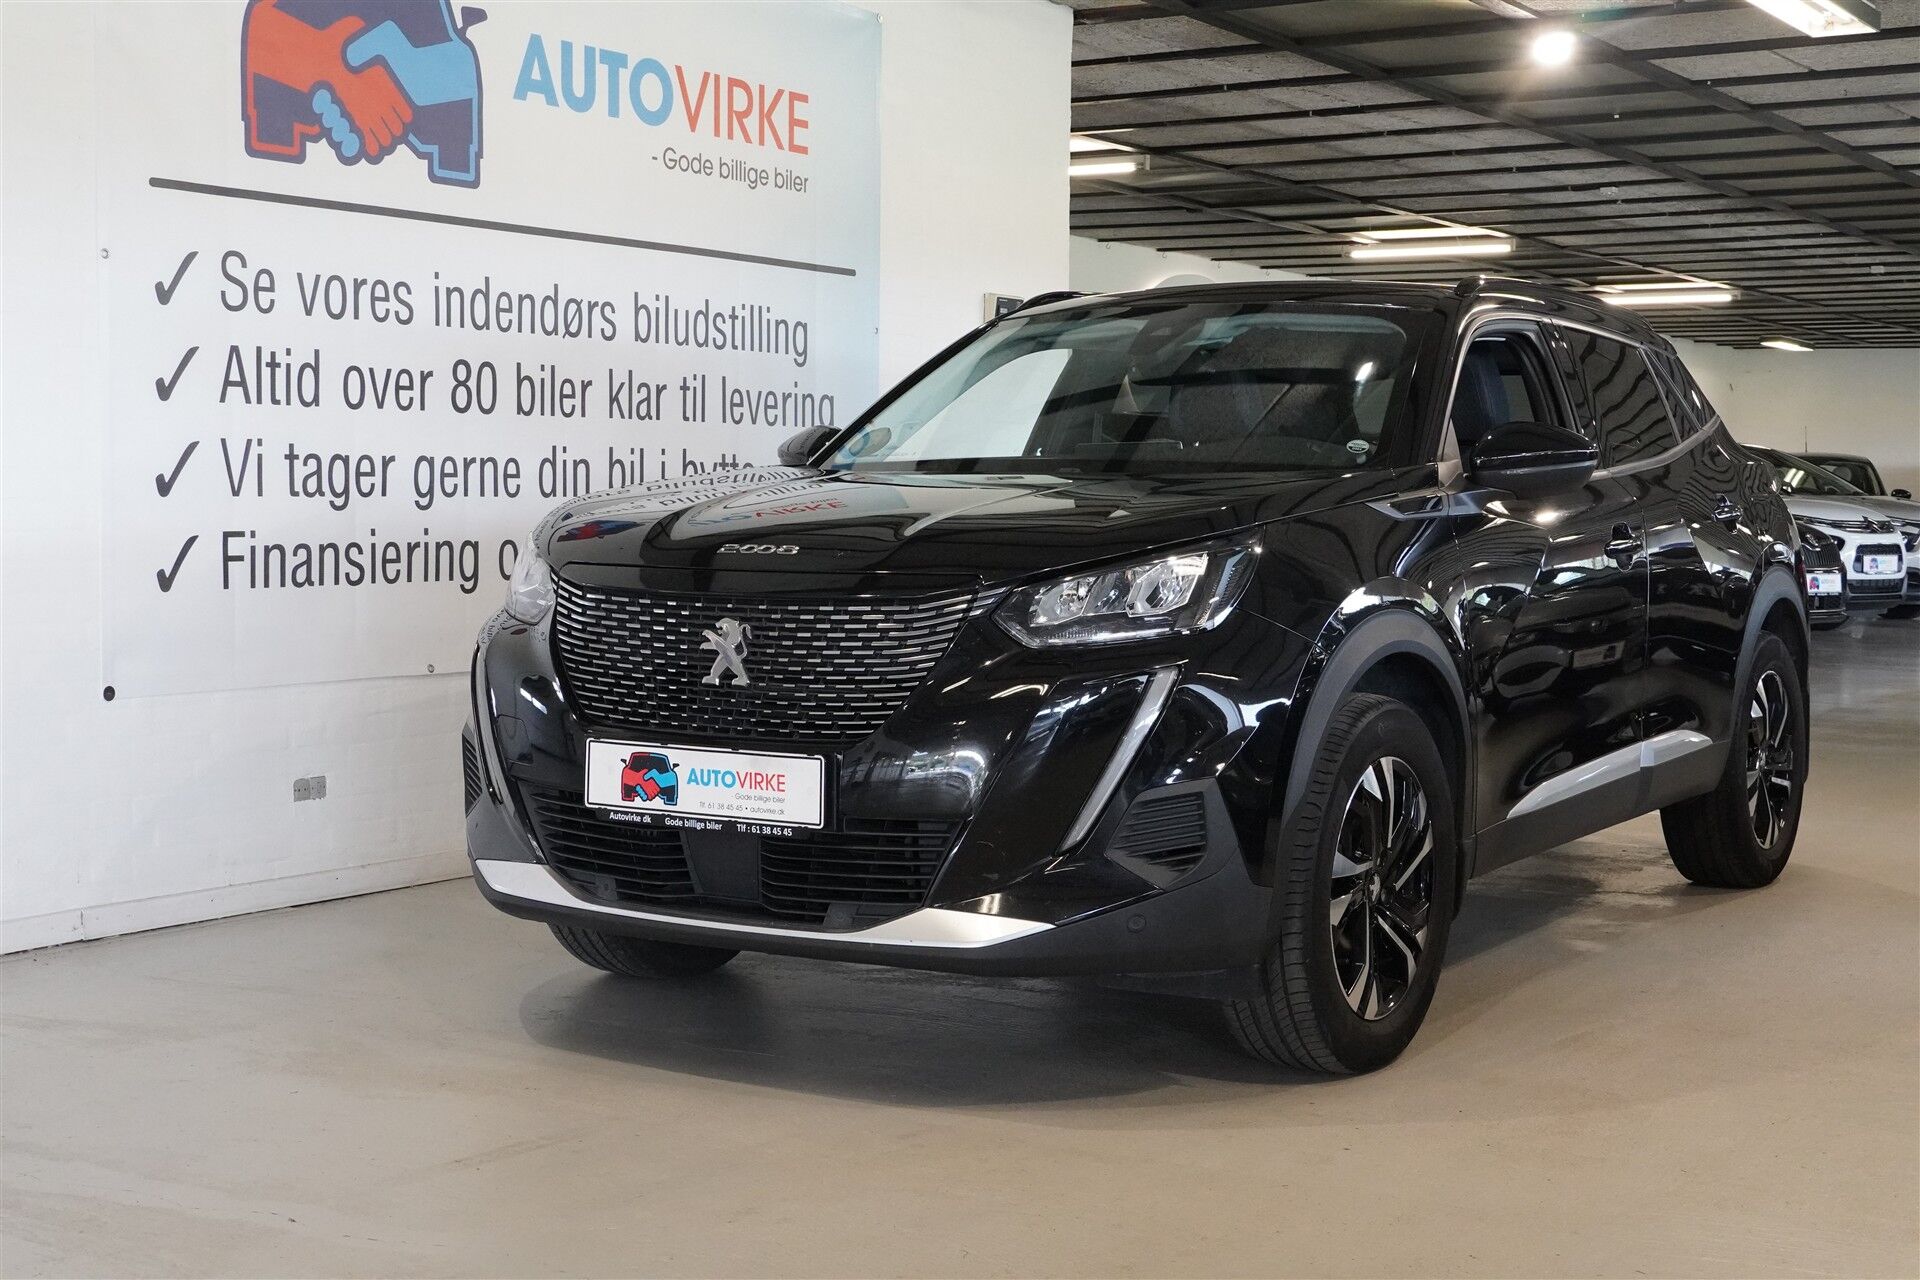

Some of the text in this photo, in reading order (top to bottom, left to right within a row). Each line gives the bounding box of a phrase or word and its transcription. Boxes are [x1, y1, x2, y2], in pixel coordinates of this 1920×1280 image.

[513, 33, 810, 155] AUTOVIRKE
[662, 146, 714, 177] Gode
[719, 156, 769, 190] billige
[774, 167, 809, 193] biler
[220, 250, 808, 368] Se vores indendørs biludstilling
[219, 344, 320, 408] Altid
[342, 363, 434, 413] over
[450, 358, 498, 415] 80
[516, 361, 593, 419] biler
[608, 368, 668, 422] klar
[679, 373, 706, 423] til
[220, 437, 264, 498] Vi
[283, 442, 396, 512] tager
[413, 454, 521, 512] gerne
[538, 444, 591, 499] din
[608, 446, 645, 491] bil
[222, 527, 520, 595] Finansiering o
[716, 543, 800, 555] 2008
[687, 767, 786, 793] AUTOVIRKE
[735, 793, 752, 801] Gode
[753, 794, 771, 804] billige
[609, 811, 641, 823] Autovirke
[665, 817, 723, 831] Gode billige biler
[751, 825, 760, 834] 61
[762, 826, 771, 835] 38
[772, 827, 782, 836] 45
[783, 828, 792, 836] 45
